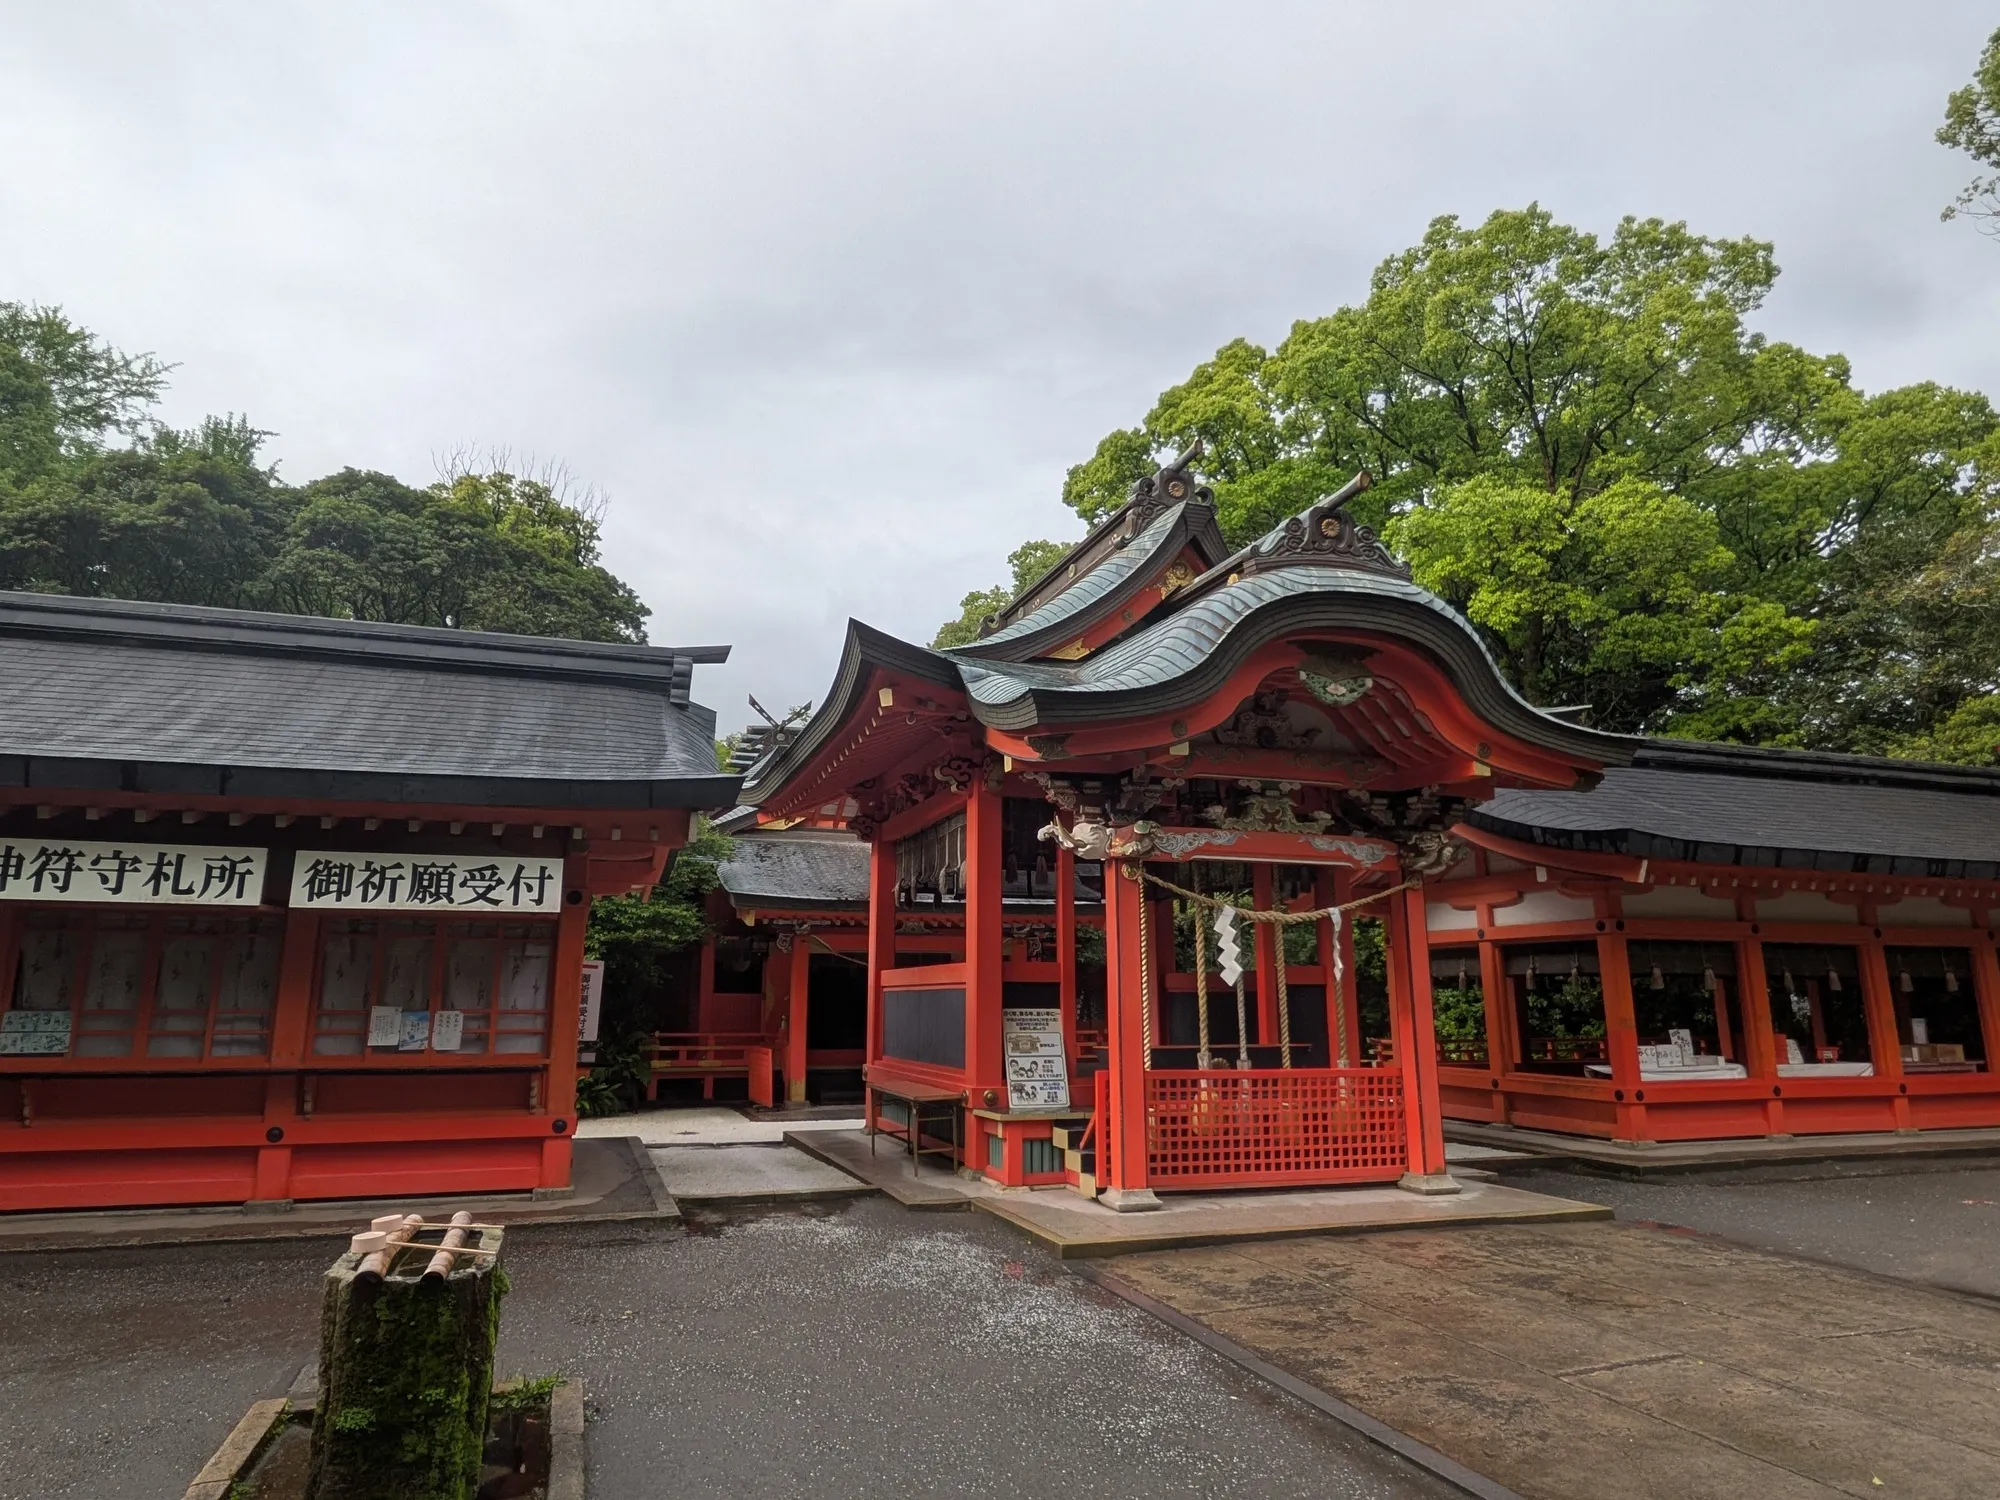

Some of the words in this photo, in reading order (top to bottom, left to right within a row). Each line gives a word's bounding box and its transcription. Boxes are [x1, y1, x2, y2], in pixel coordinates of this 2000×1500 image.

[301, 858, 554, 906] 御祈願受付
